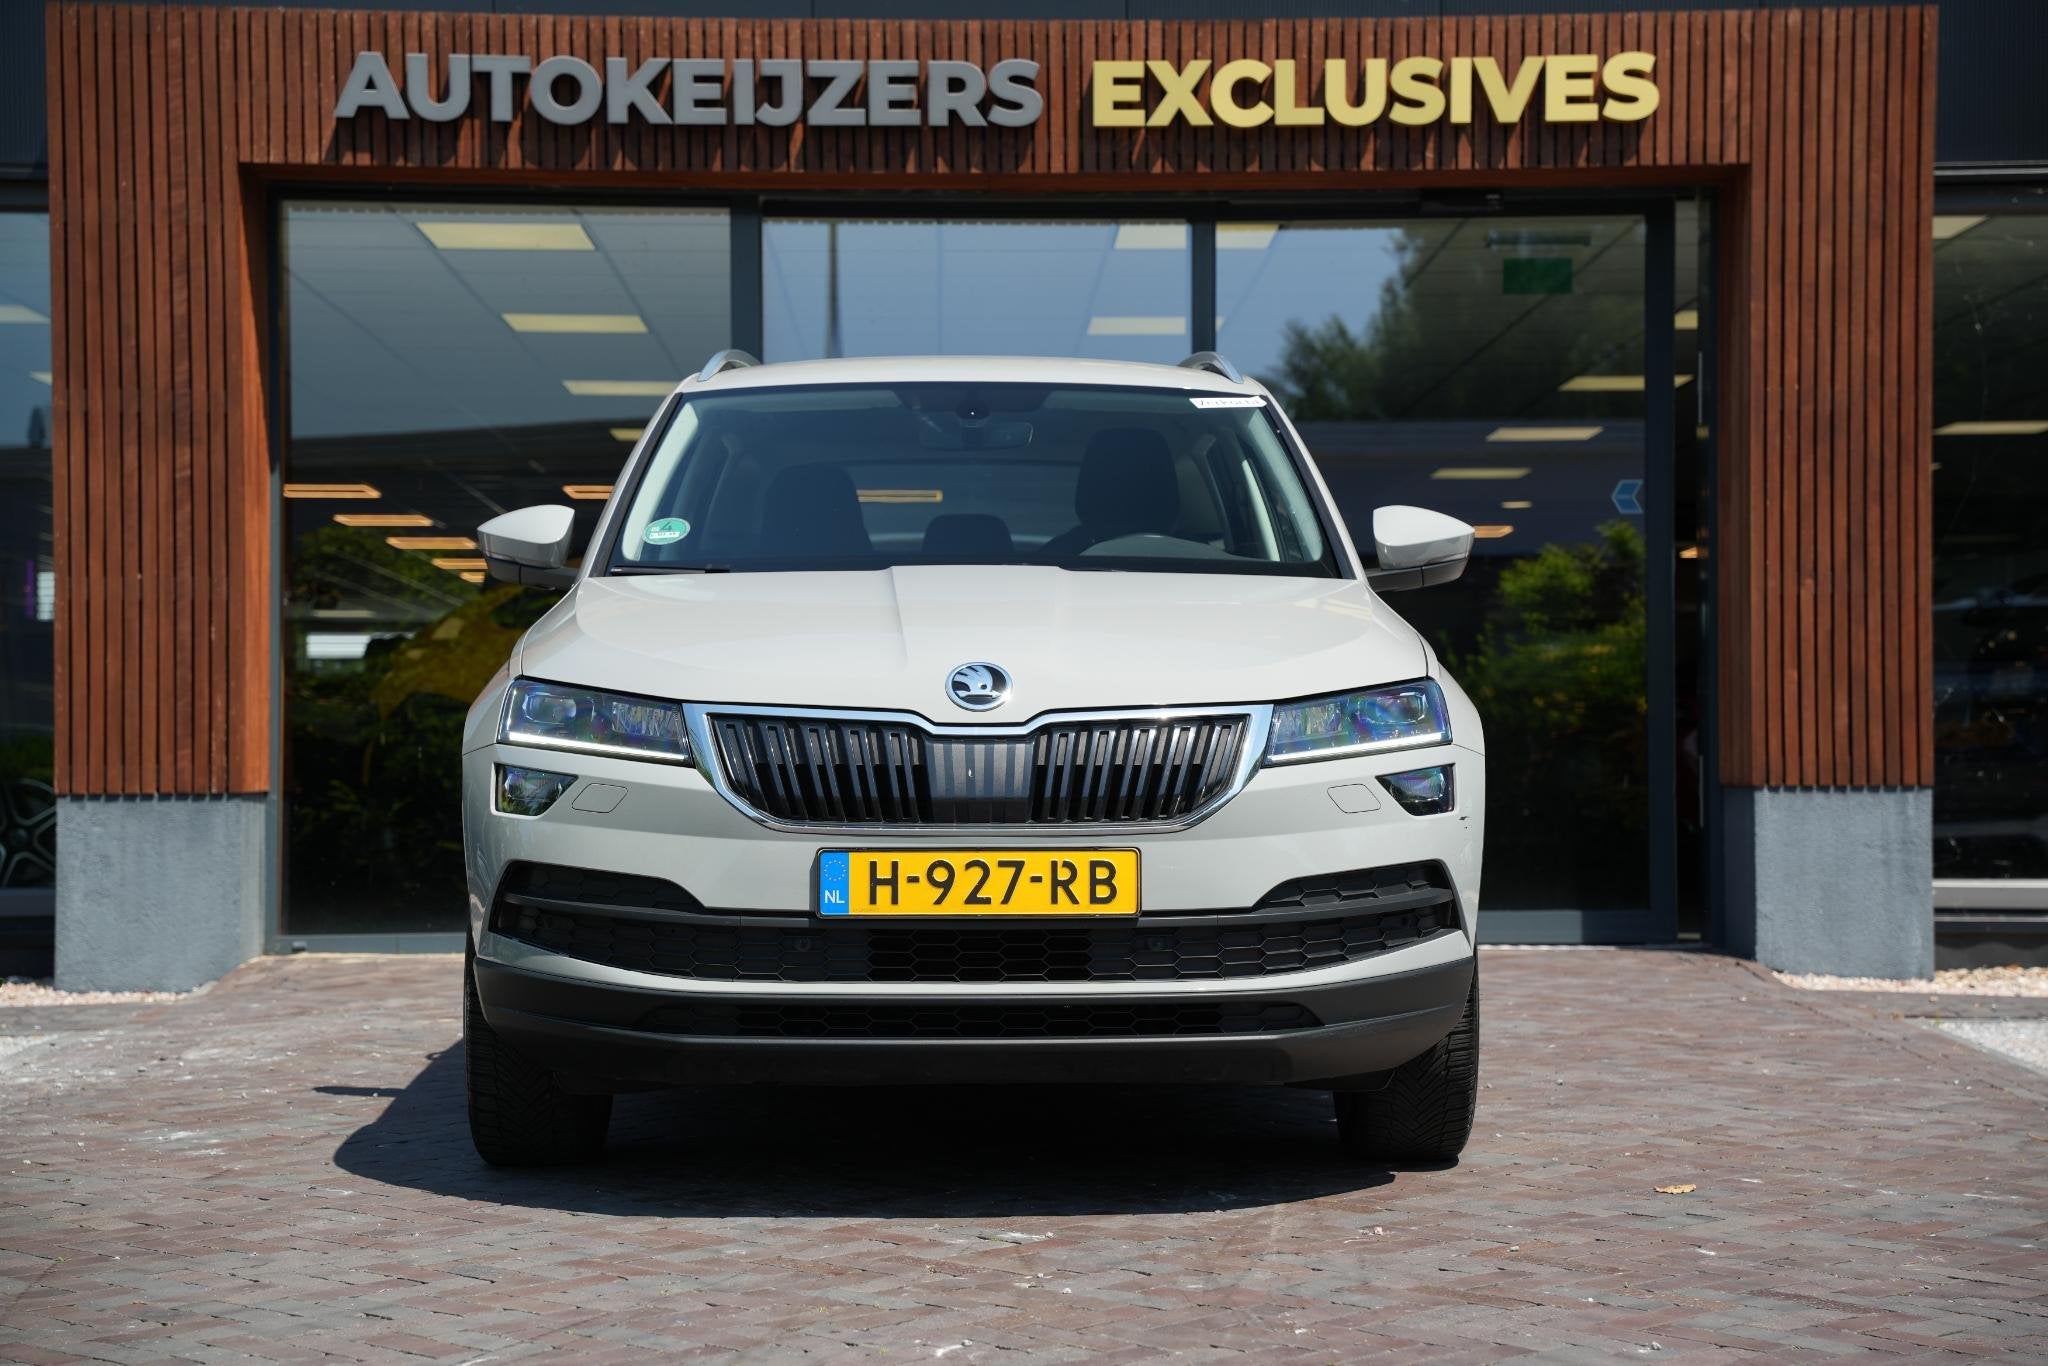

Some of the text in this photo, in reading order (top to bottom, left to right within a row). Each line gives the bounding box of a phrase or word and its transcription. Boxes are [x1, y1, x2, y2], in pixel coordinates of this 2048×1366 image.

[335, 51, 1660, 128] AUTOKEIJZERS EXCLUSIVES
[824, 890, 845, 904] NL
[868, 859, 1118, 905] H-927-RB
